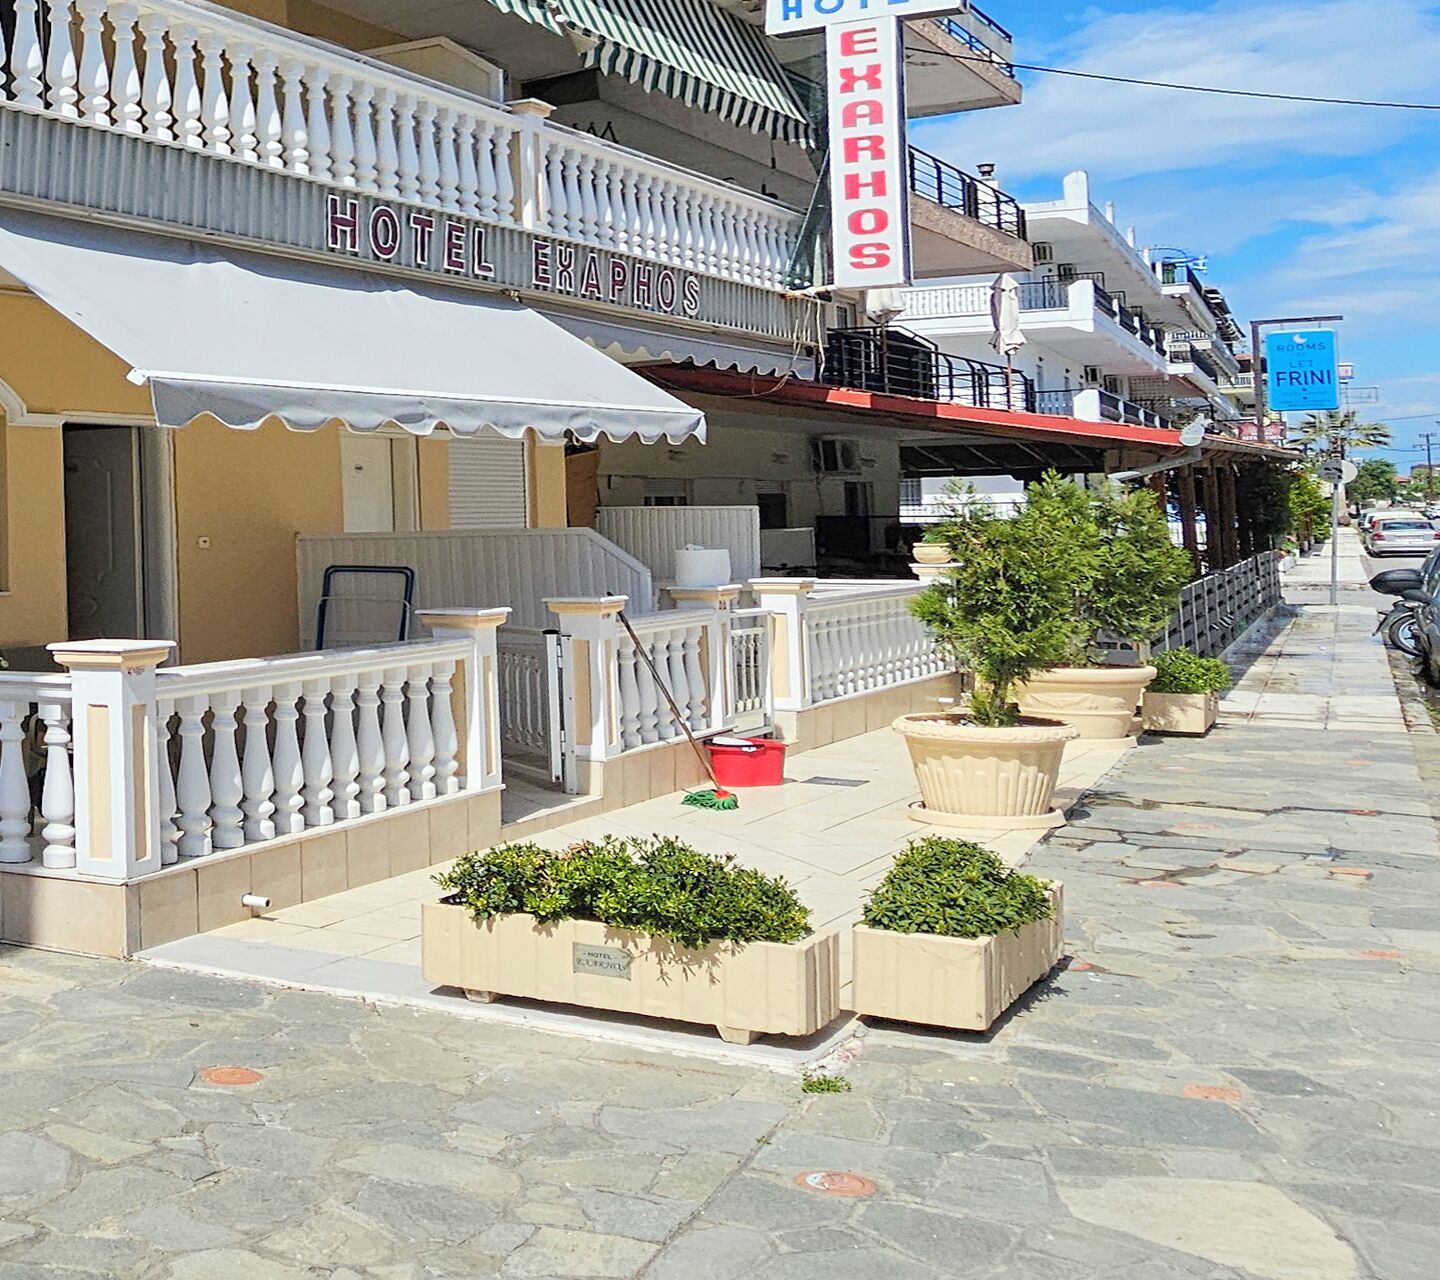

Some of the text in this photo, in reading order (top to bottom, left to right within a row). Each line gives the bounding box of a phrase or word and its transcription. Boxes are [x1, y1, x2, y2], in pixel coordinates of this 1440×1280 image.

[839, 26, 892, 270] EXARHOS
[326, 193, 495, 279] HOTEL
[1276, 342, 1326, 352] ROOMS
[1289, 359, 1314, 368] LET
[1275, 369, 1332, 387] FRINI
